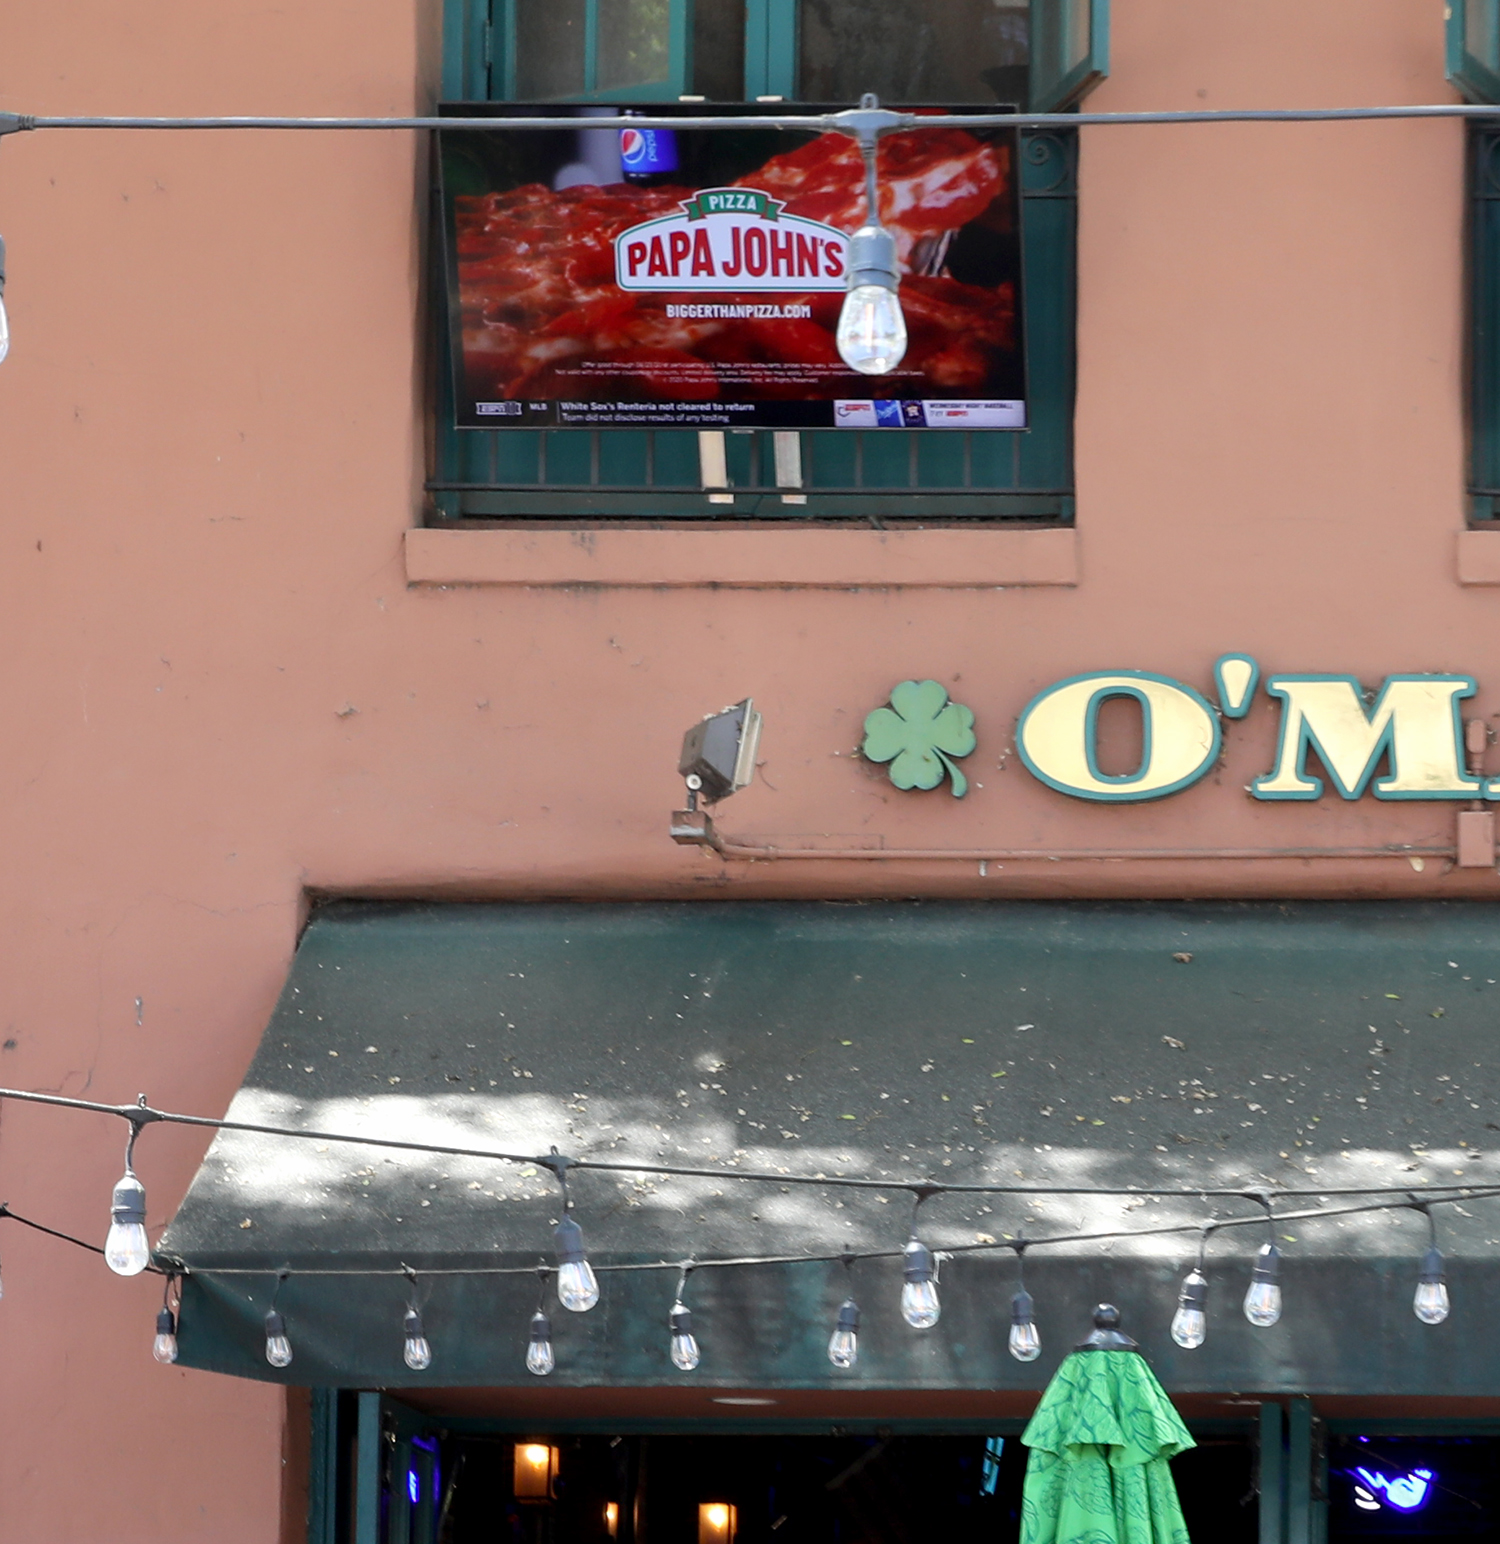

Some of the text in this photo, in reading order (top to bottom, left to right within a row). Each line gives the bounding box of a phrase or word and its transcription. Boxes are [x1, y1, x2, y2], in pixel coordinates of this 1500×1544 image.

[708, 194, 758, 211] PIZZA
[627, 227, 844, 278] PAPA JOHN'S
[666, 304, 811, 319] BIGGERTHANPIZZA.COM
[560, 401, 588, 412] White
[658, 401, 674, 412] not
[676, 401, 711, 412] cleared
[712, 401, 723, 412] to
[724, 401, 755, 412] return
[614, 413, 648, 421] disclose
[676, 413, 685, 421] of
